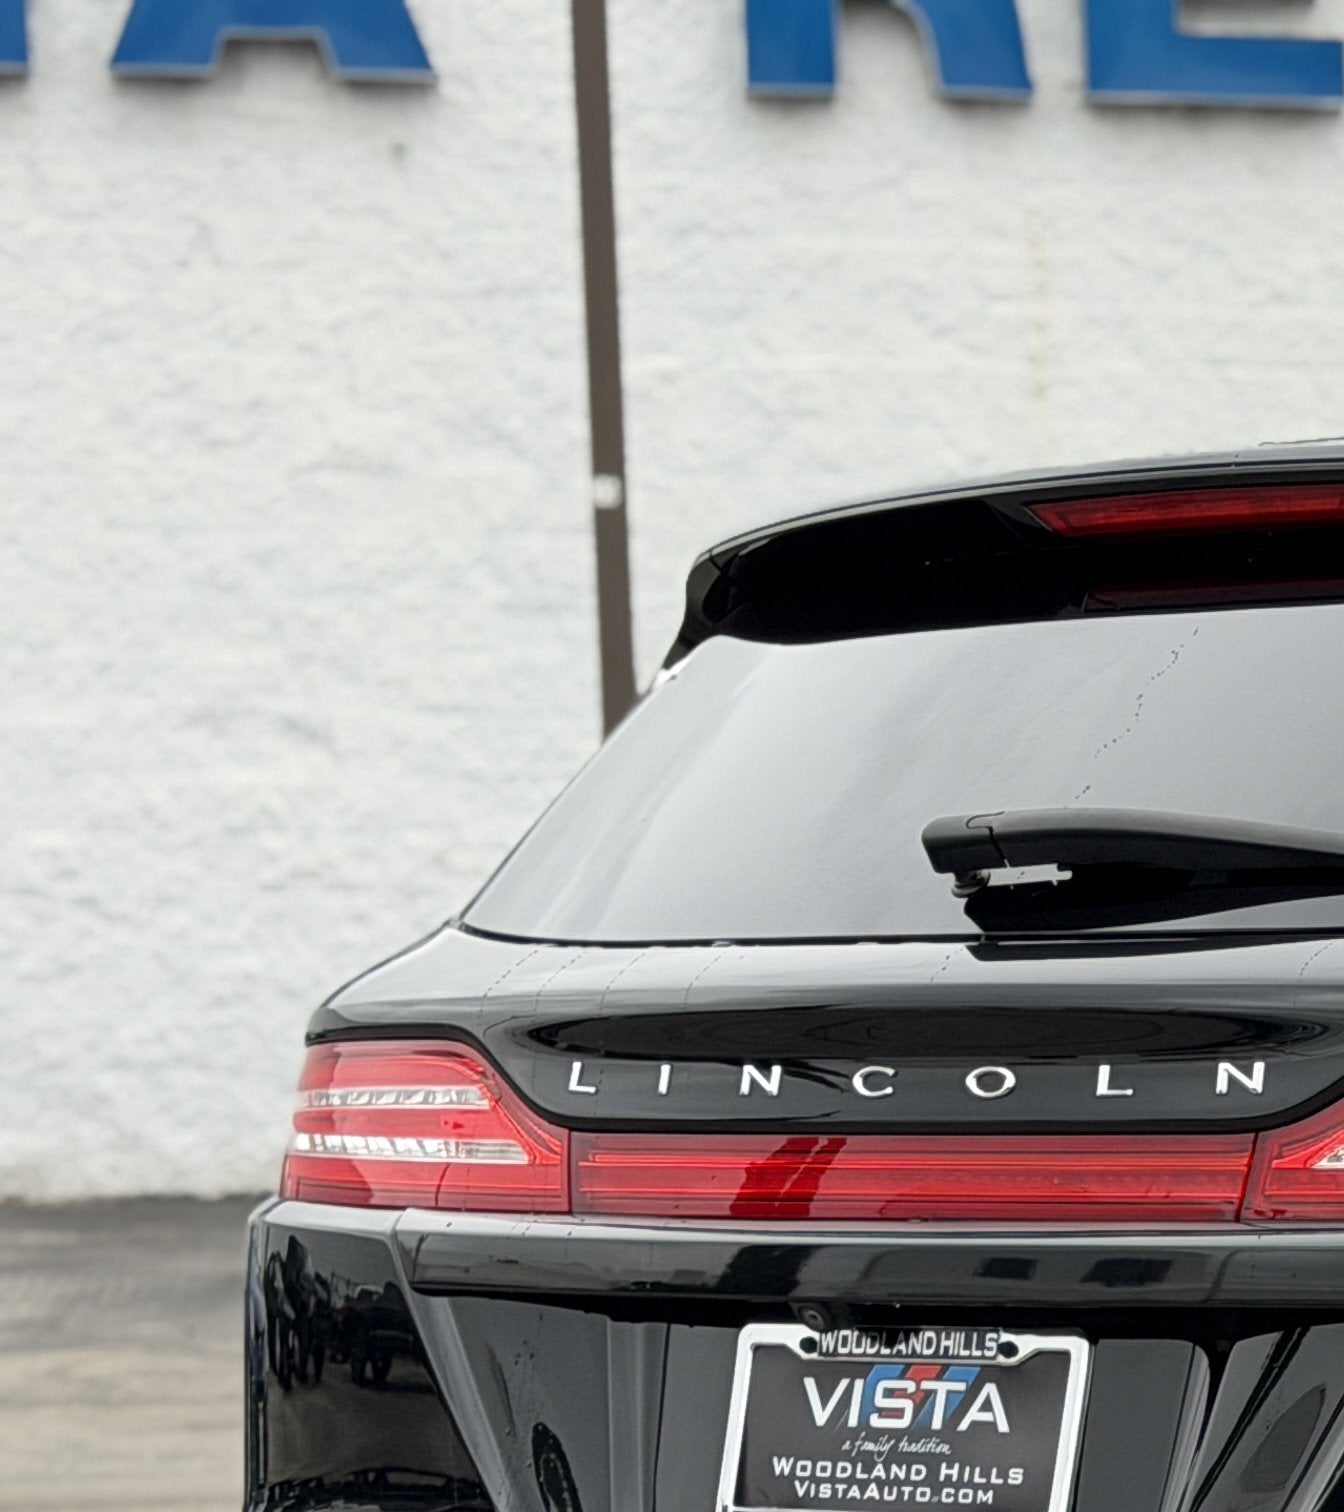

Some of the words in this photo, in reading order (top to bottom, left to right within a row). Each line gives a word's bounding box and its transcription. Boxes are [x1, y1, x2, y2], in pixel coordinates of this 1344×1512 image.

[567, 1060, 1267, 1098] LINCOLN
[820, 1328, 937, 1357] WOODLAND
[939, 1329, 999, 1358] HILLS
[802, 1376, 1011, 1434] VISTA
[851, 1430, 896, 1462] family
[898, 1434, 952, 1455] tradition
[772, 1455, 928, 1482] WOODLAND
[938, 1461, 1025, 1486] HILLS
